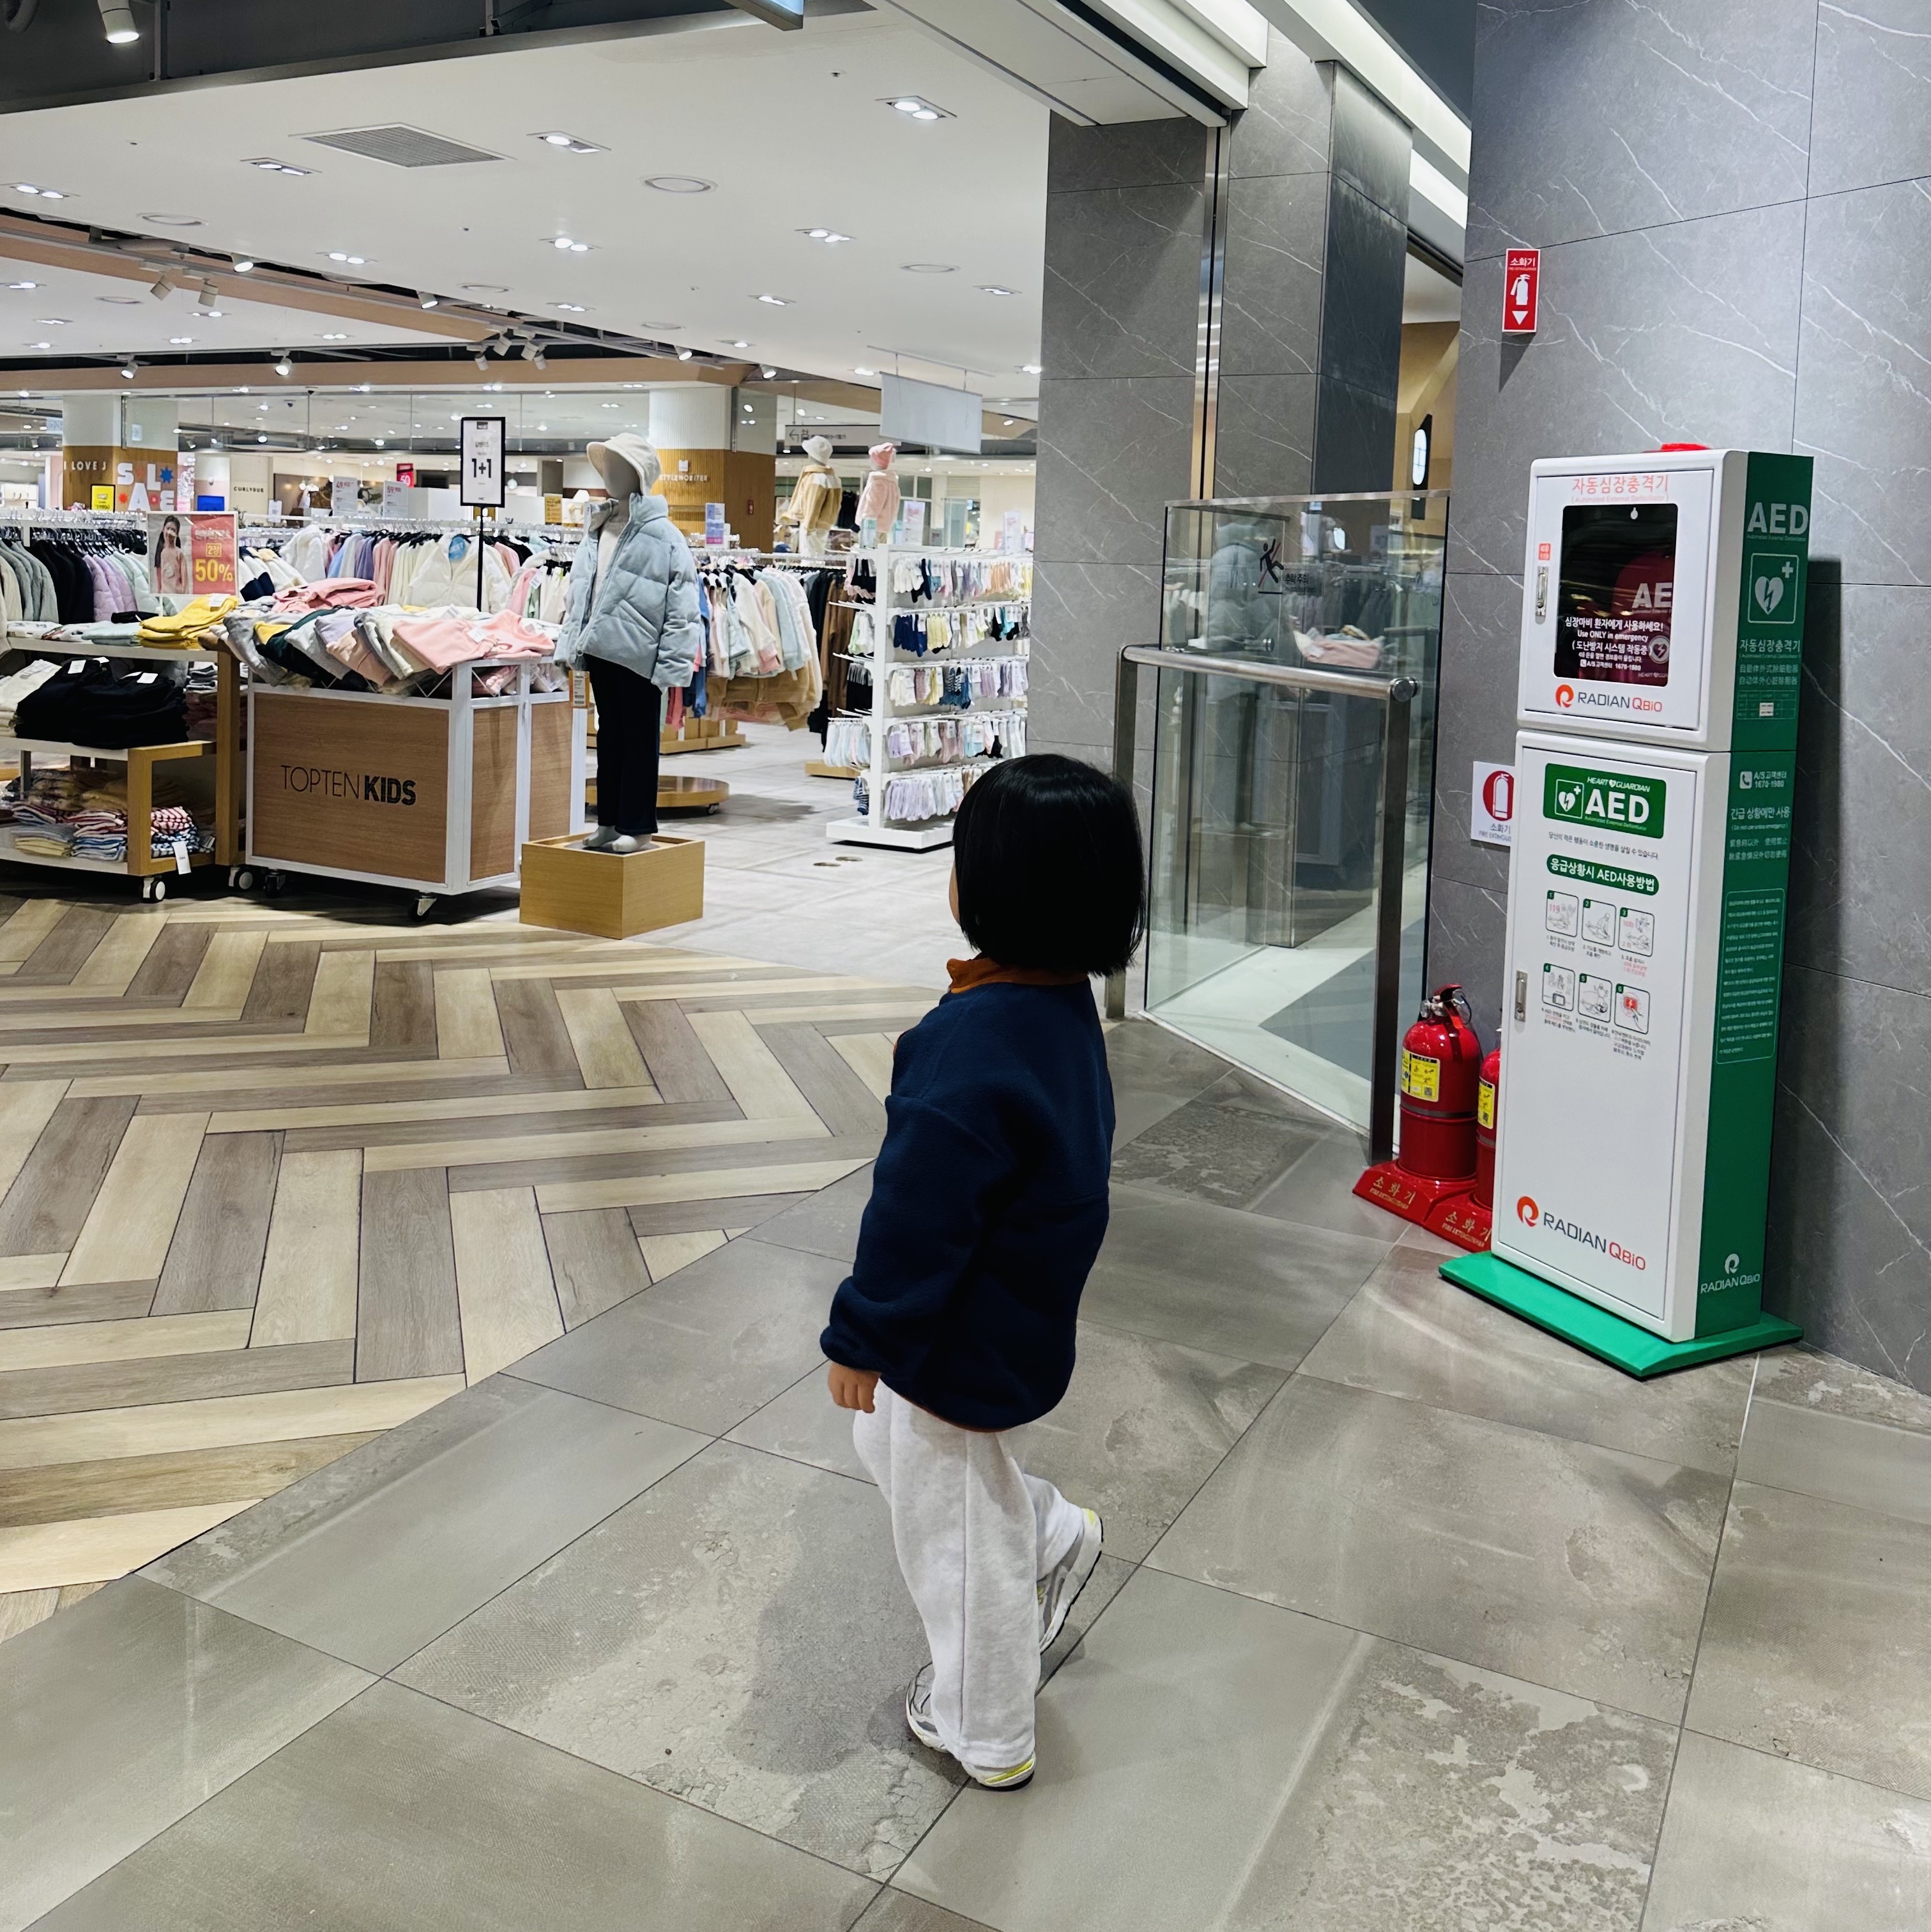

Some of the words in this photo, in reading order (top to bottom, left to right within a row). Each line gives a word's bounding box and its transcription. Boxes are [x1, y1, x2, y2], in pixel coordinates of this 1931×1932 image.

[1510, 258, 1536, 266] 소화기
[72, 461, 97, 471] LOVE
[472, 459, 491, 478] 1+1
[1573, 475, 1668, 494] 자동심장충격기
[1747, 502, 1808, 535] AED
[195, 559, 233, 582] 50%
[1566, 617, 1592, 628] 심장마비
[1594, 618, 1622, 630] 환자에게
[1624, 620, 1663, 632] 사용하세요!
[1615, 633, 1648, 643] emergency
[1739, 639, 1801, 653] 자동심장충격기
[1605, 643, 1625, 653] 시스템
[1578, 692, 1630, 708] RADIAN
[281, 764, 359, 800] TOPTEN
[364, 775, 416, 806] KIDS
[1587, 777, 1608, 786] HEART
[1615, 781, 1650, 793] GUARDIAN
[1585, 788, 1649, 824] AED
[1731, 808, 1746, 820] 긴급
[1746, 807, 1775, 819] 상황에만
[1776, 806, 1790, 818] 사용
[1490, 823, 1511, 835] 소화기
[1550, 858, 1594, 879] 응급상황시
[1597, 869, 1654, 892] AED사용방법
[1549, 904, 1561, 913] 119
[1543, 1211, 1607, 1253] RADIAN
[1700, 1277, 1739, 1294] RADIAN
